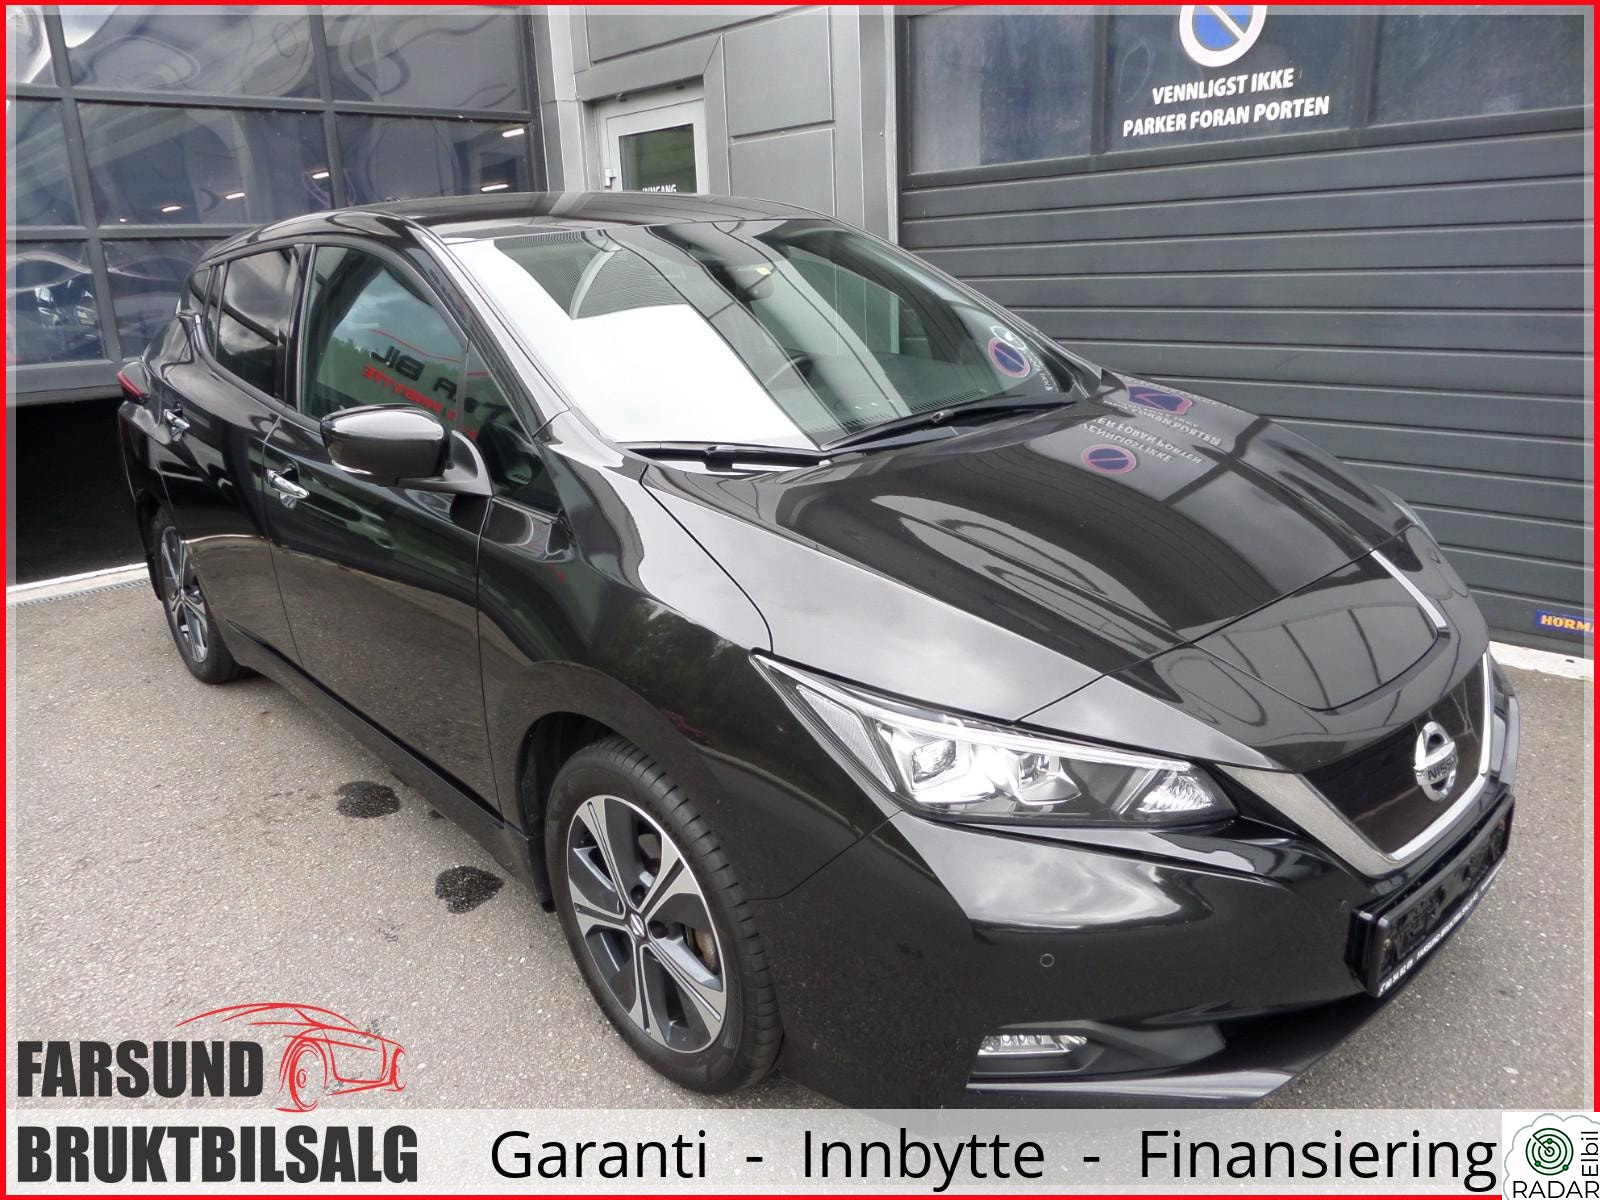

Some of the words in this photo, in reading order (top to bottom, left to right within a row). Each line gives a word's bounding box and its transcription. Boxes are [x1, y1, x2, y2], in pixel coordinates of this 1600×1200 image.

[1152, 75, 1248, 105] VENNLIGST
[1251, 68, 1295, 92] IKKE
[1123, 112, 1186, 137] PARKER
[1190, 105, 1250, 129] FORAN
[1253, 96, 1330, 123] PORTEN
[1541, 614, 1594, 632] HÖRM
